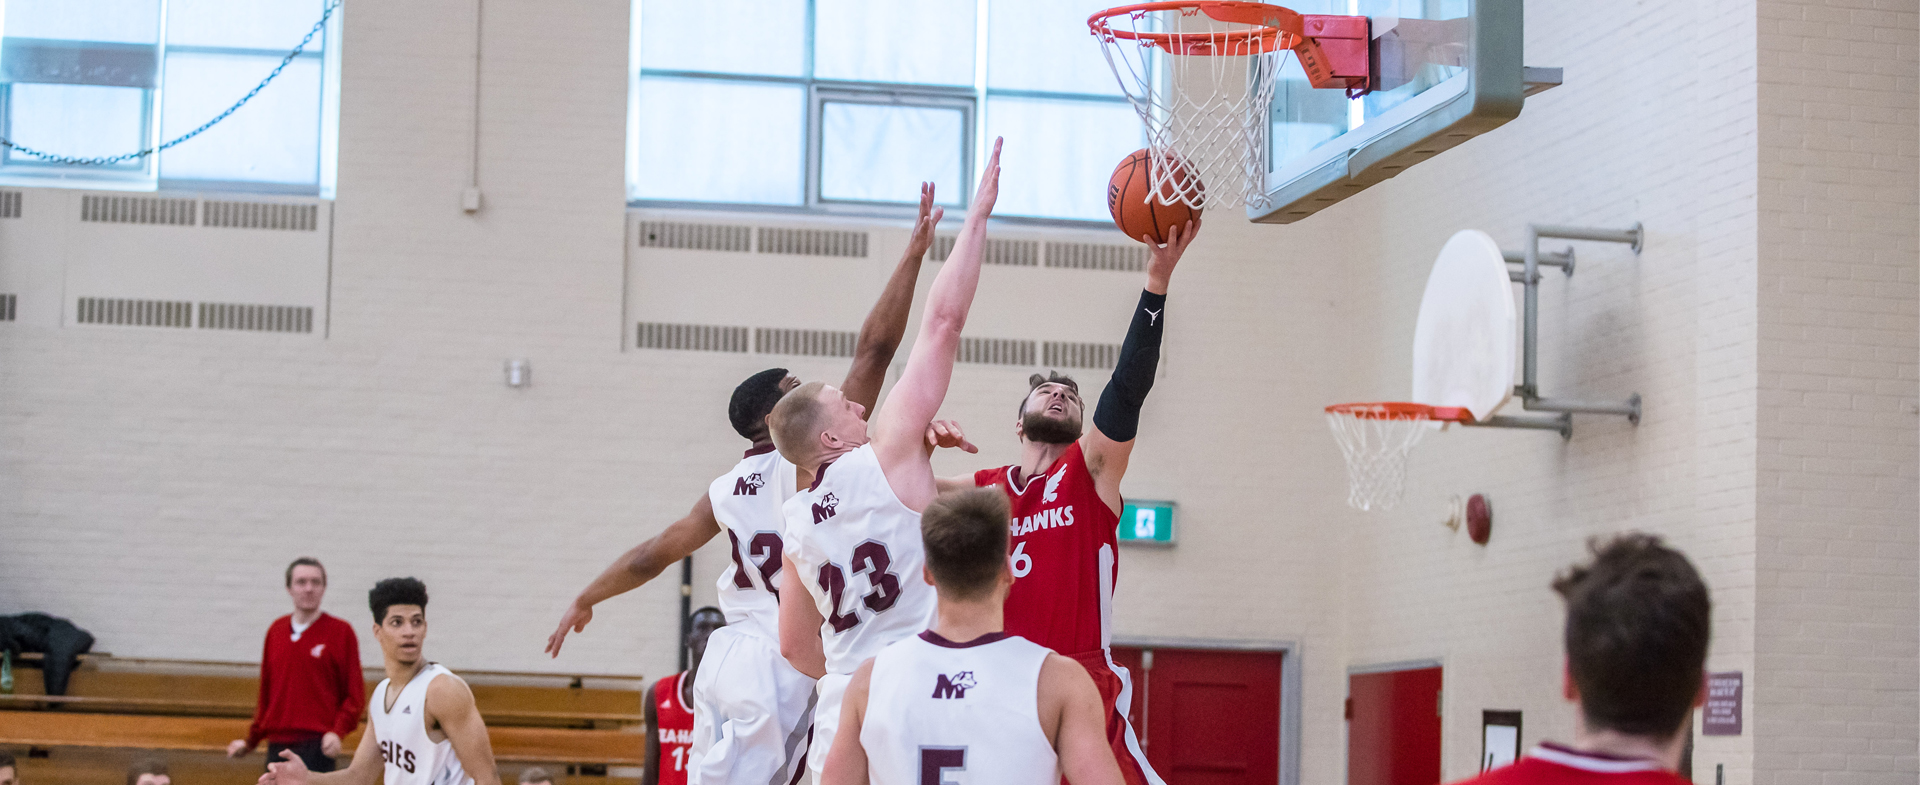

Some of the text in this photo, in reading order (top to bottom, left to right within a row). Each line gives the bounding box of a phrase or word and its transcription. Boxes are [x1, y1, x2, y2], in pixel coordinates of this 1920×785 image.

[727, 528, 784, 605] 12
[816, 538, 903, 636] 23
[1010, 541, 1033, 578] 6
